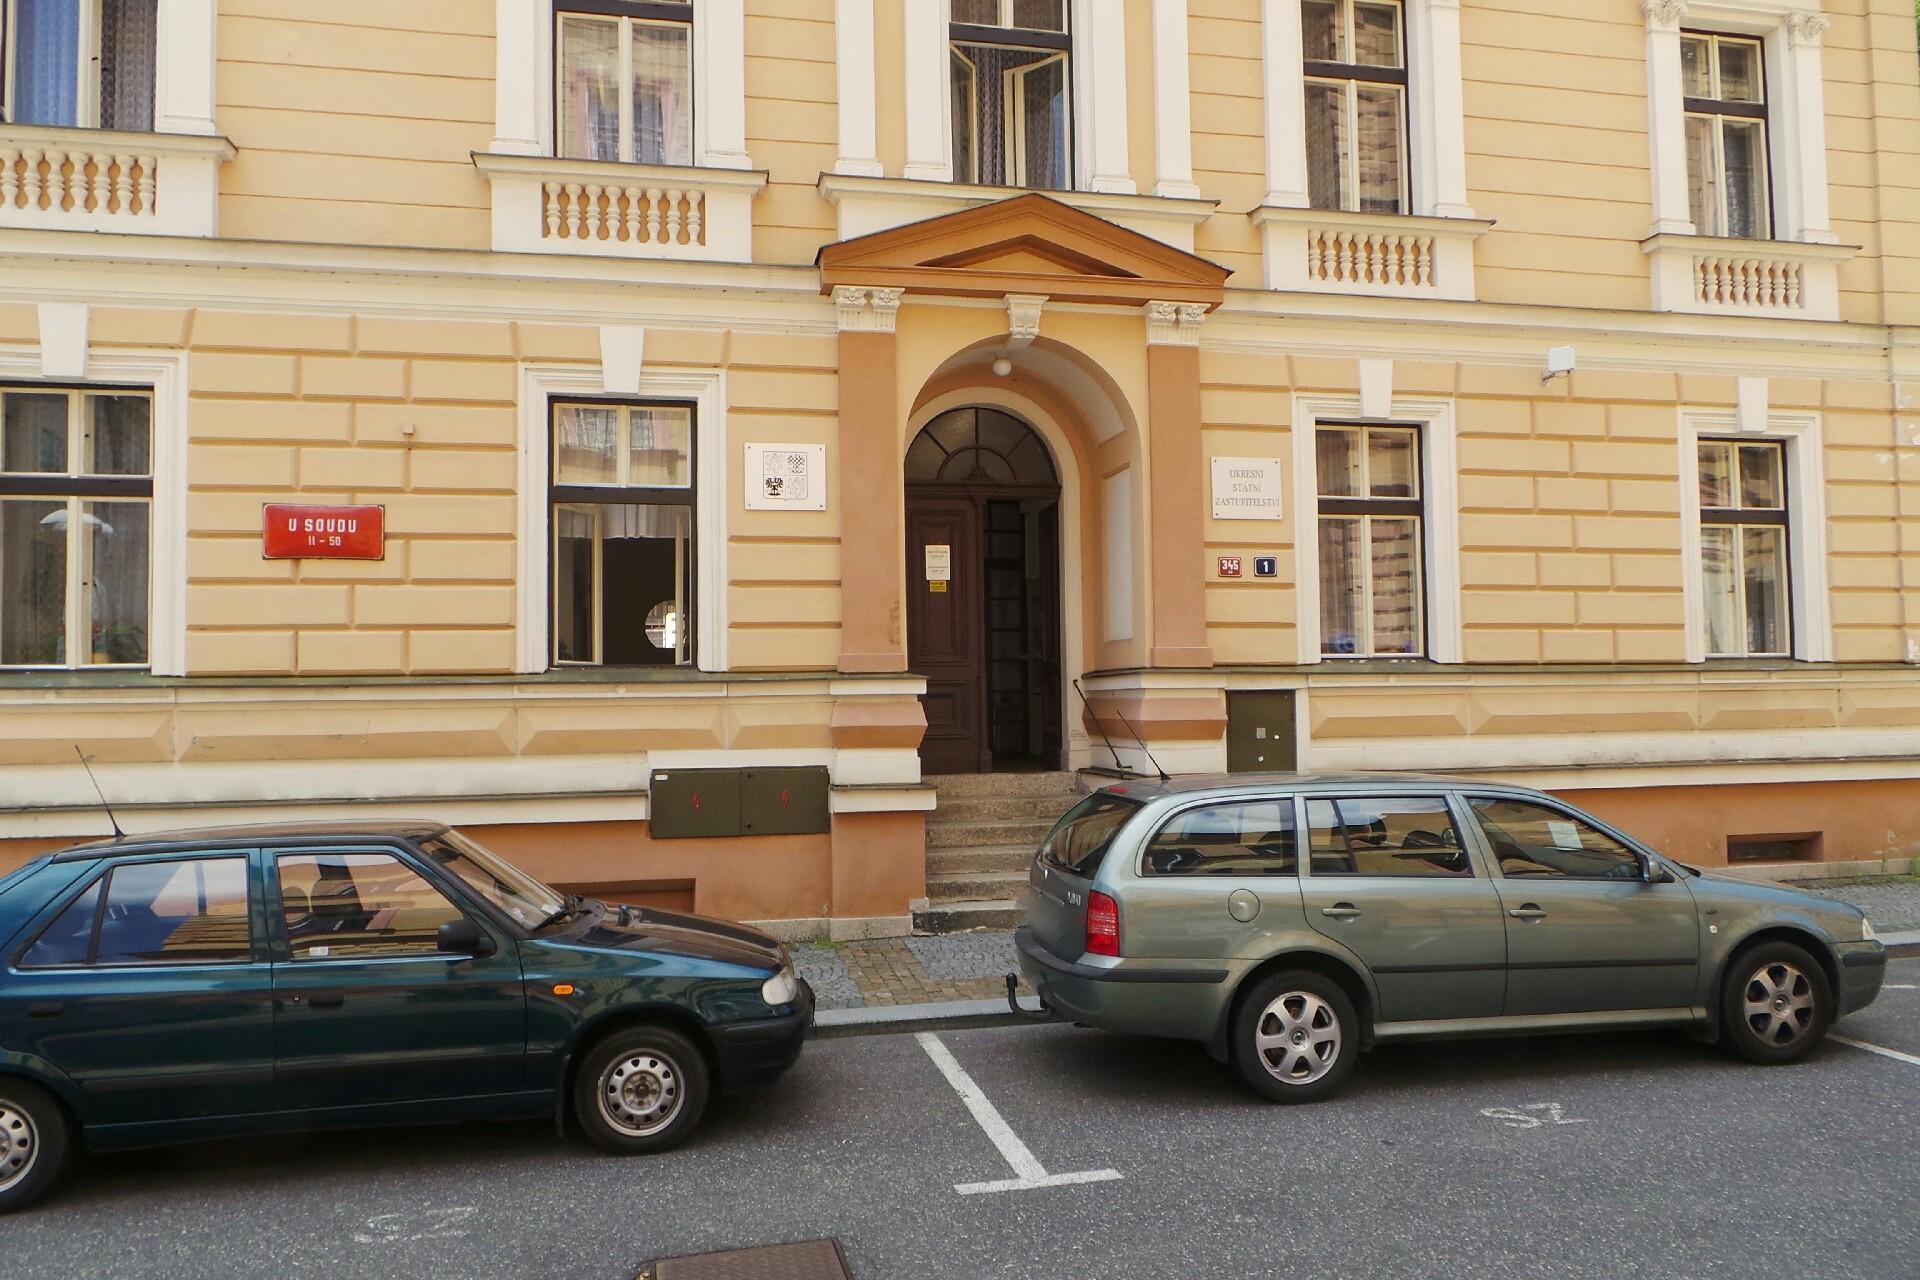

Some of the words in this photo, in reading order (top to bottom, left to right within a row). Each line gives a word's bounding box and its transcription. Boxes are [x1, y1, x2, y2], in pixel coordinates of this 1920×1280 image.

[288, 518, 297, 532] U
[304, 518, 357, 533] SOUDU
[329, 536, 341, 546] 50
[1222, 559, 1239, 570] 345
[1263, 560, 1269, 573] 1
